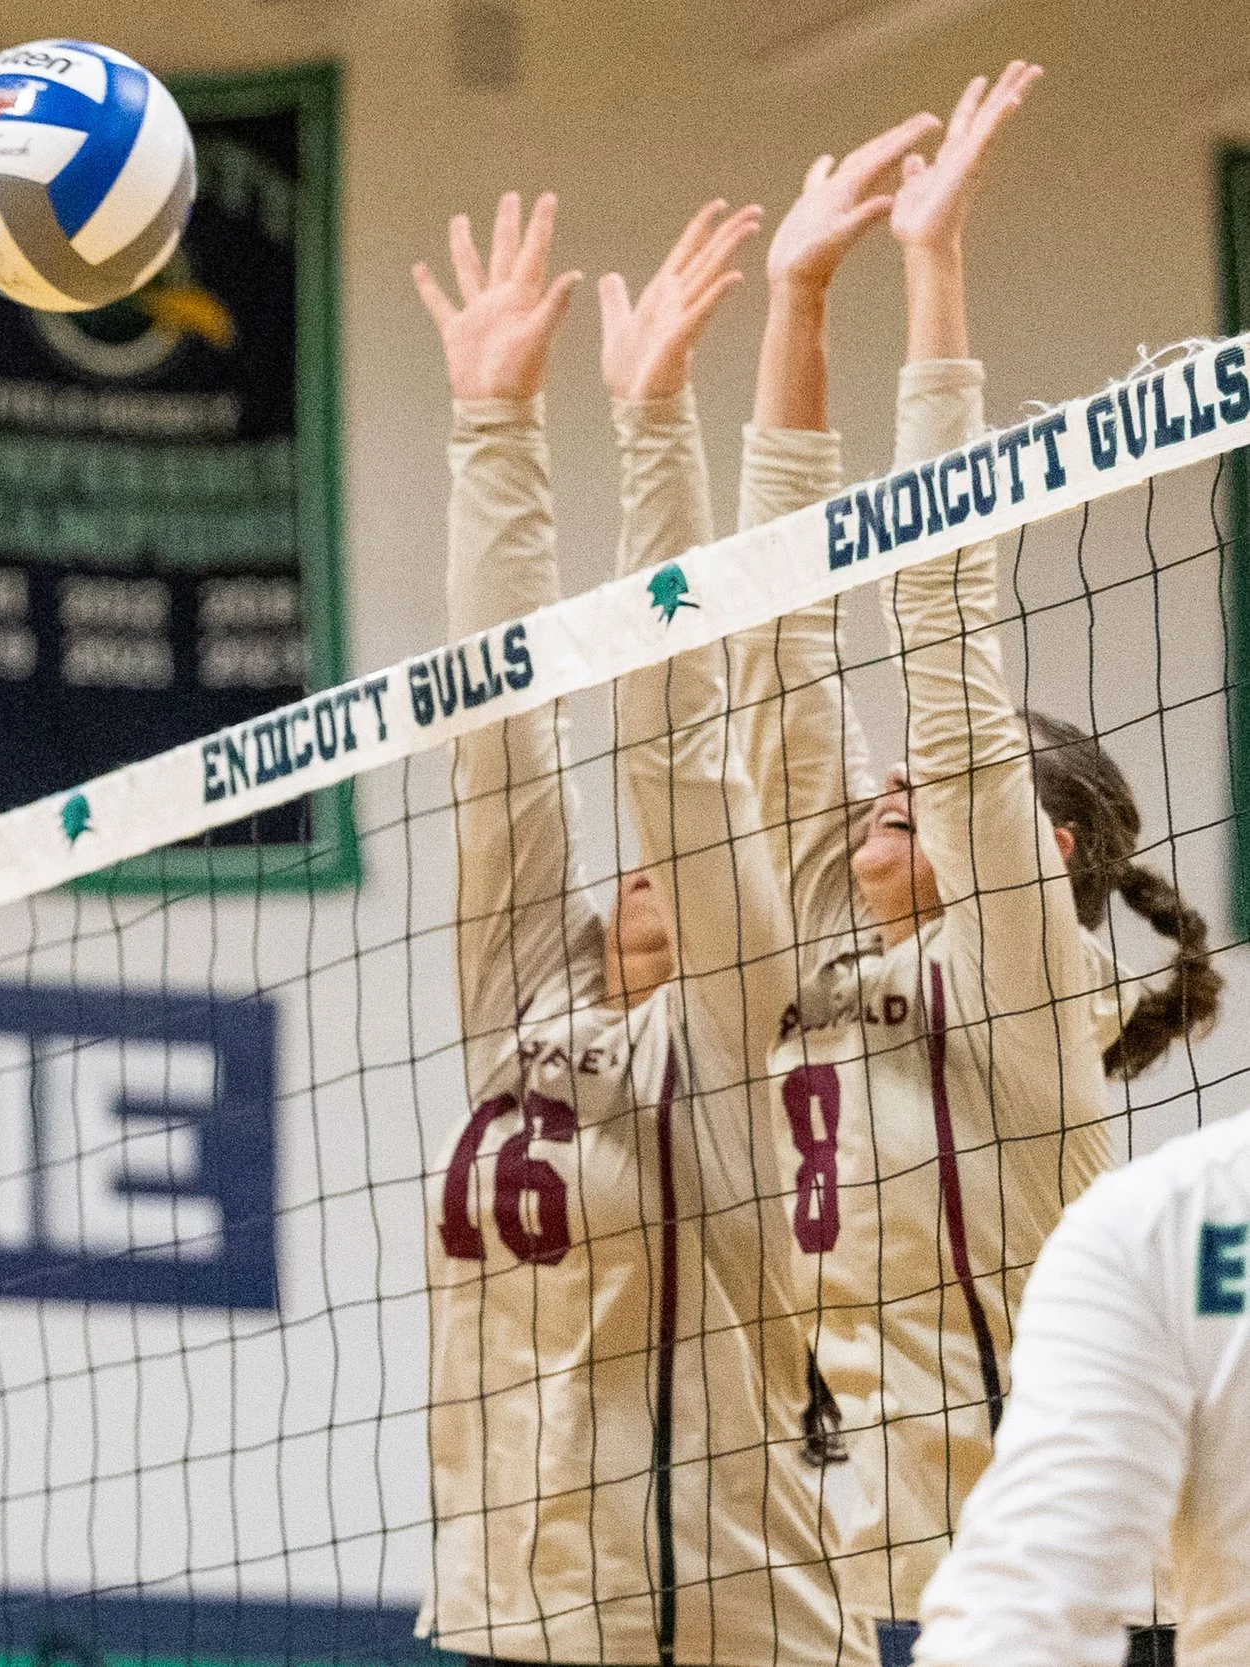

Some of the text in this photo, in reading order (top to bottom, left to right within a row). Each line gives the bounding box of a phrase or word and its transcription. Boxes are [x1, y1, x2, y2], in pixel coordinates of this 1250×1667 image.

[825, 345, 1250, 572] ENDICOTT GULLS
[201, 673, 390, 804] ENDICOTT
[406, 621, 536, 728] GULLS
[437, 1088, 581, 1267] 16
[781, 1062, 842, 1254] 8
